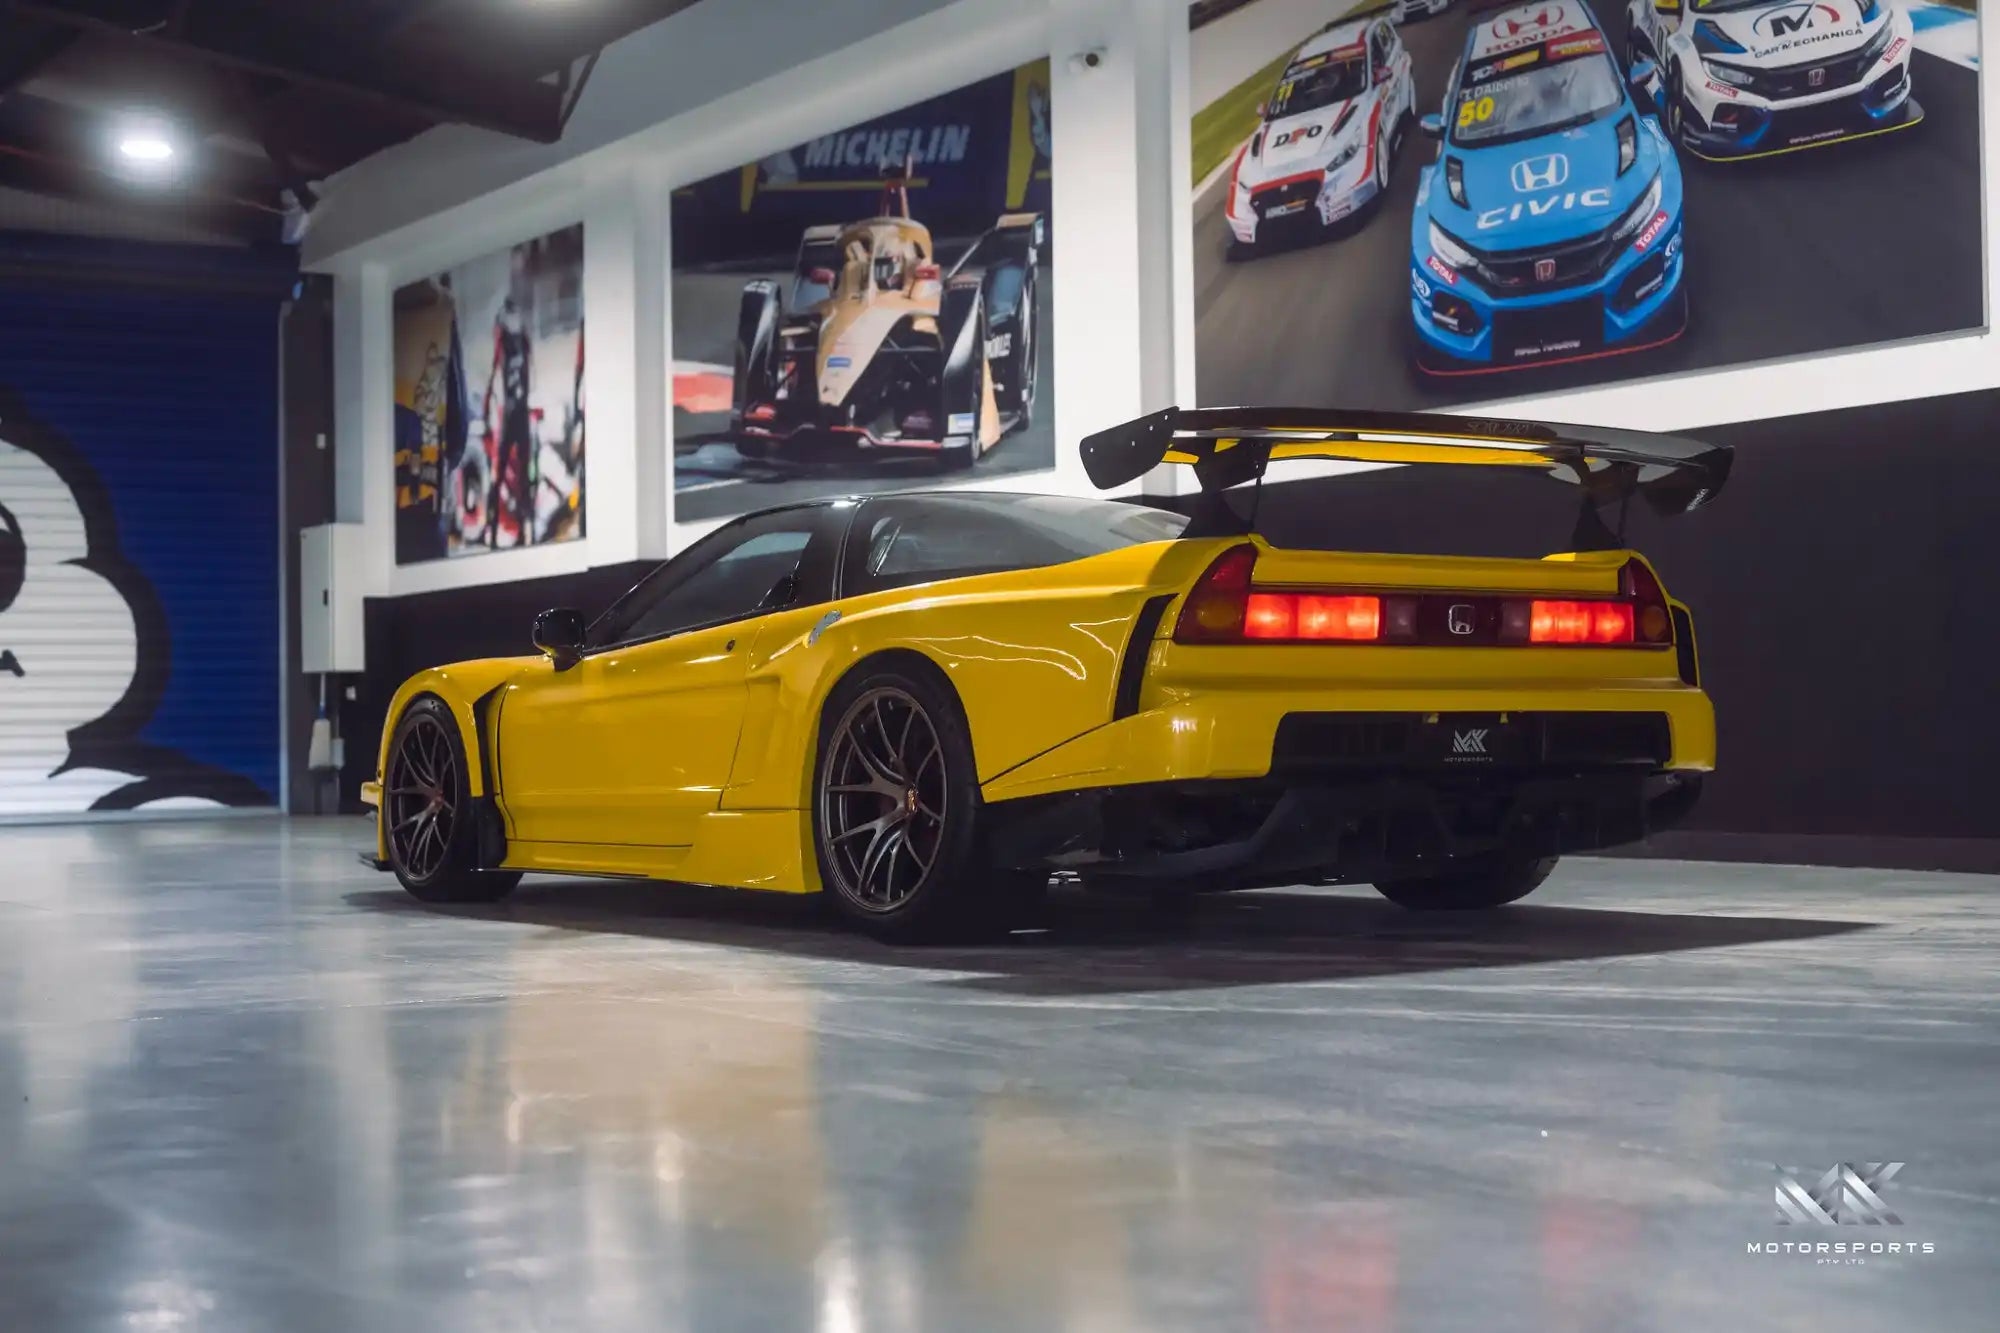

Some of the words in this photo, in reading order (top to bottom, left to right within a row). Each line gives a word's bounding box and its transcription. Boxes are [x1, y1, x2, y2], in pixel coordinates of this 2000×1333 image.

[1485, 25, 1575, 54] HONDA
[1754, 46, 1779, 58] CAR
[1781, 28, 1863, 50] MECHANICA
[1458, 96, 1495, 128] 50
[805, 125, 970, 168] MICHELIN
[1476, 188, 1611, 230] CIVIC
[1634, 214, 1667, 249] TOTAL
[1429, 256, 1454, 284] TOTAL
